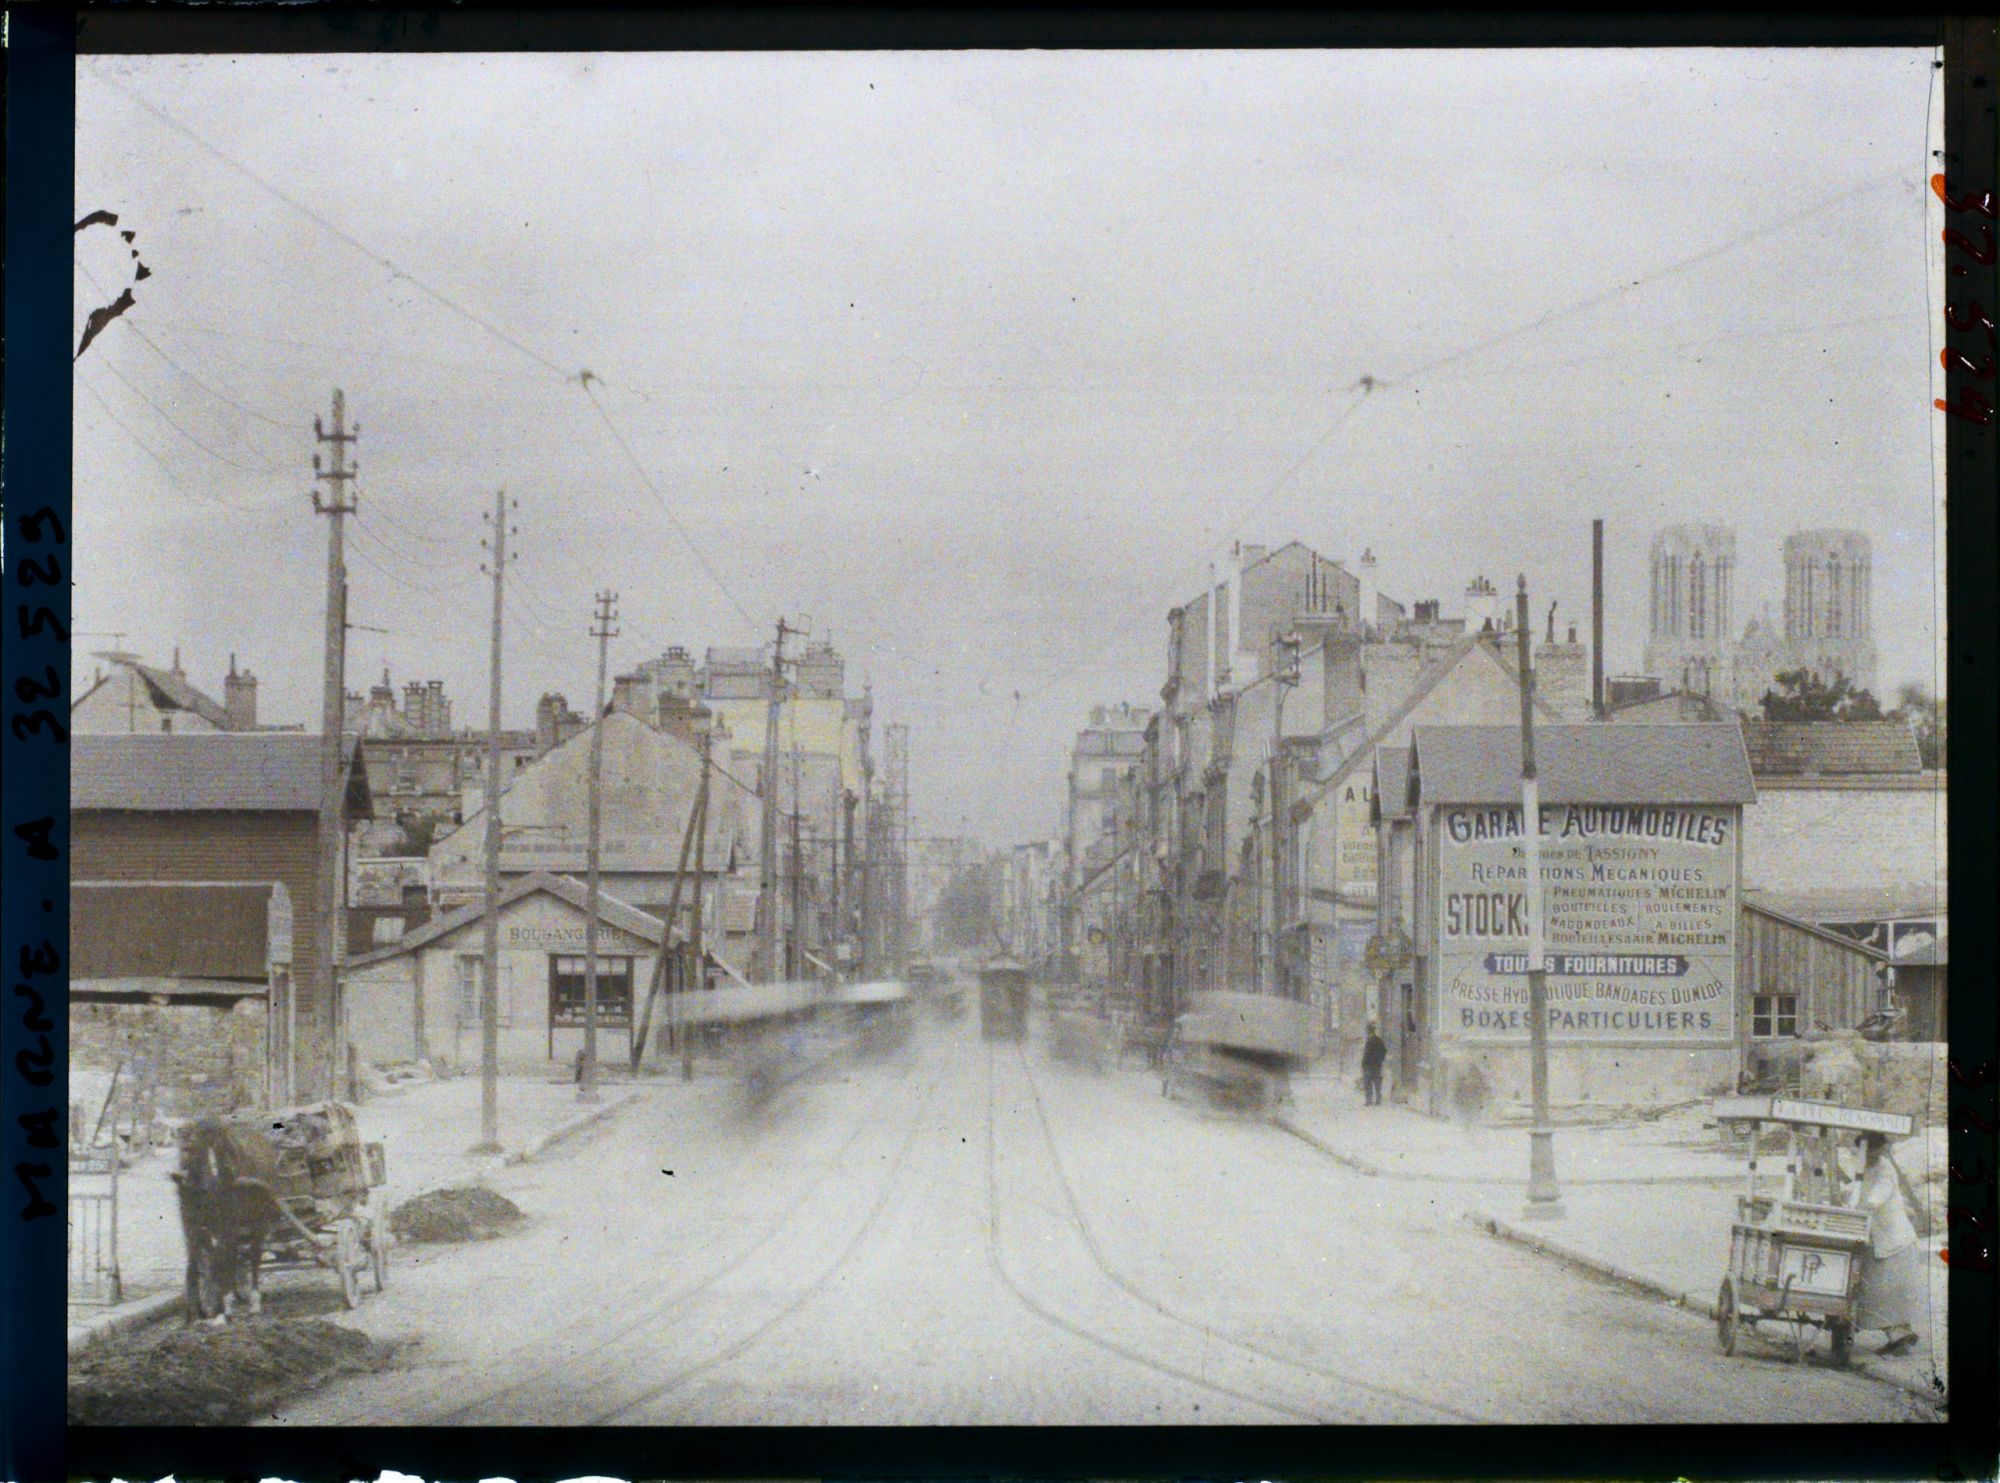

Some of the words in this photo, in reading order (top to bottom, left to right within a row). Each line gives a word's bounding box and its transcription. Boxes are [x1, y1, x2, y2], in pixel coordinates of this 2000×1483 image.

[1447, 806, 1551, 843] GARAE
[1560, 803, 1728, 846] AUTOMOBILES
[1472, 862, 1585, 884] REPARTIONS
[1592, 863, 1703, 882] MECANIQUES
[1552, 886, 1652, 899] PNEUMATIQUES
[1446, 892, 1528, 937] STOCK
[1552, 902, 1628, 914] BOUTEILLES
[1645, 903, 1722, 915] ROULEMENTS
[1669, 919, 1712, 931] BILLES
[508, 928, 622, 941] BOULANGRIE
[1494, 956, 1555, 974] TOUS
[1564, 956, 1678, 974] FOURNITURES
[1451, 978, 1499, 1003] PRESSE
[1503, 984, 1589, 1004] HYDULIQUE
[1595, 981, 1666, 1006] BANDAGES
[1671, 979, 1723, 1005] DUNLOP
[1461, 1007, 1532, 1029] BOXES
[1549, 1007, 1711, 1030] PARTICULIERS
